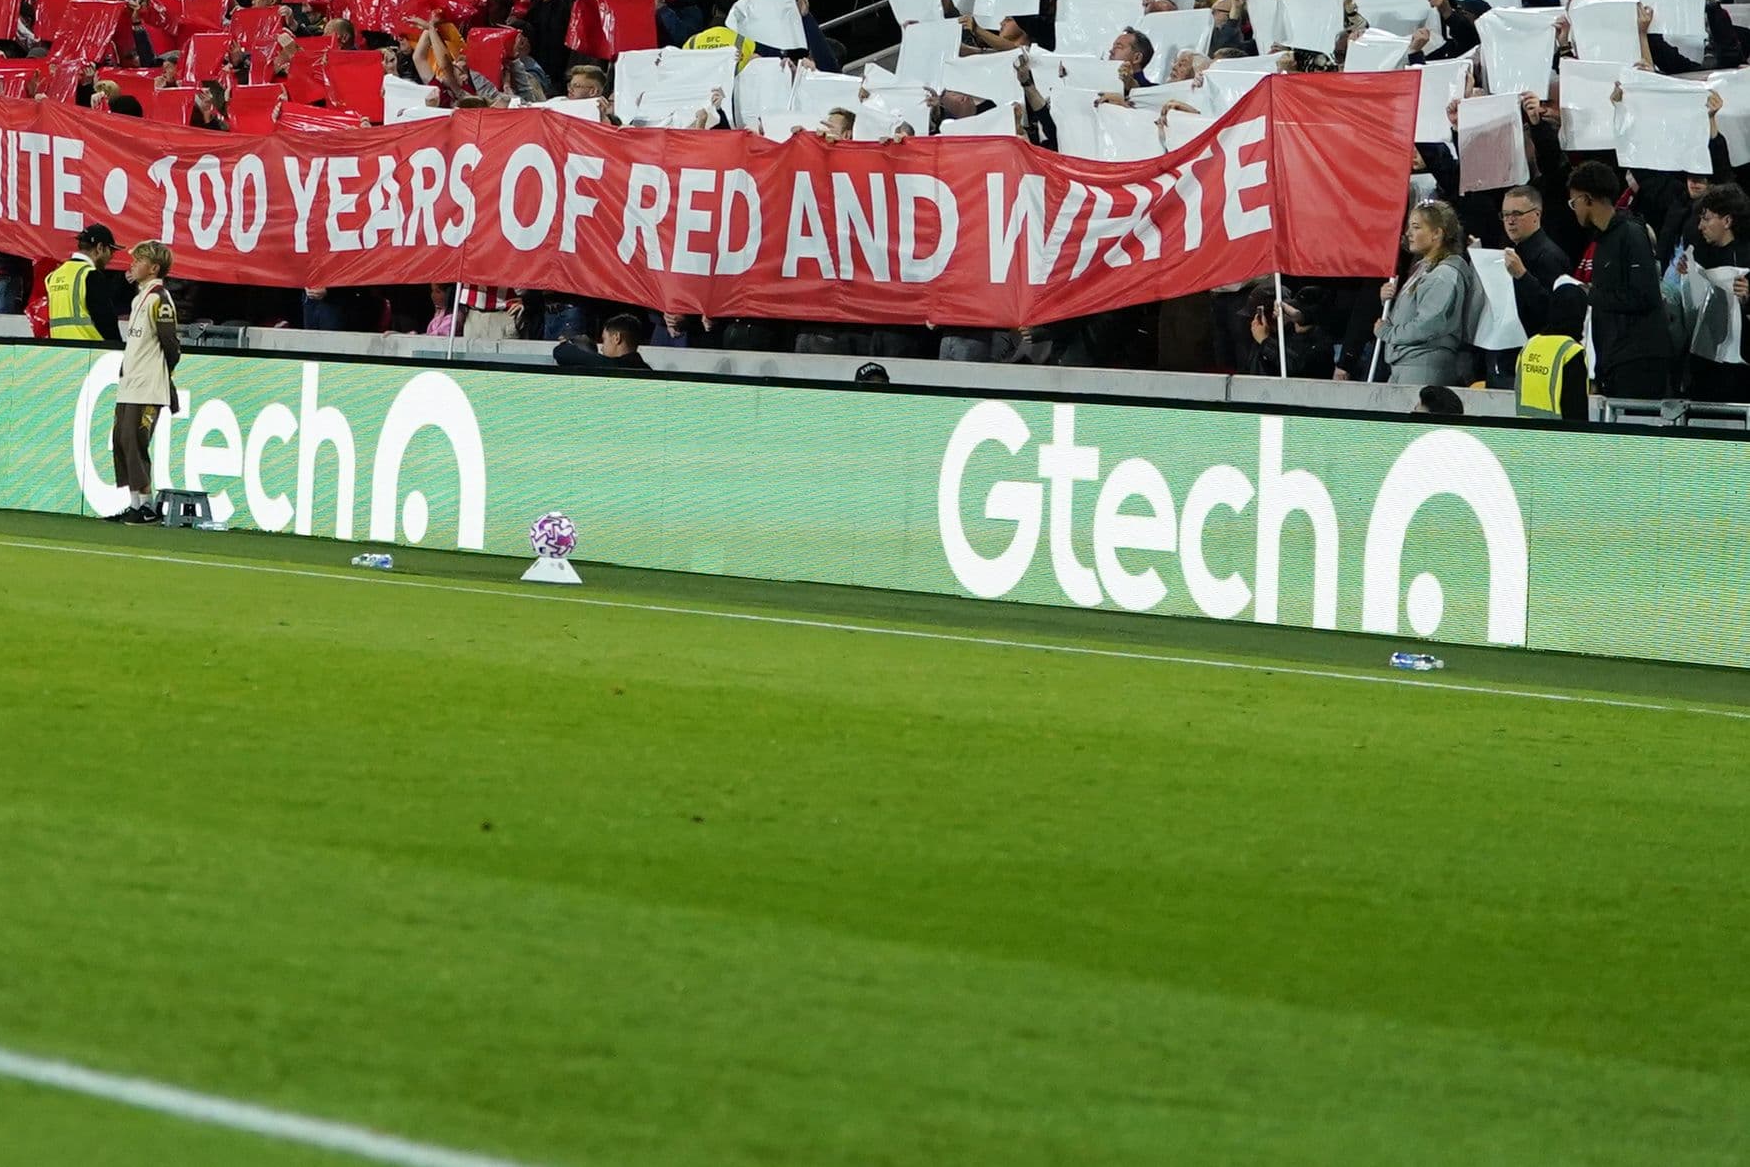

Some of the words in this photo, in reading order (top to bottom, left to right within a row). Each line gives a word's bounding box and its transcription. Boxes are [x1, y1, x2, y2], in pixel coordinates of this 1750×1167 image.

[147, 154, 267, 252] 100
[284, 143, 484, 252] YEARS
[499, 143, 605, 253] OF
[616, 163, 761, 275] RED
[782, 170, 959, 283] AND
[987, 115, 1273, 285] WHITE
[1523, 363, 1549, 376] TEWARD
[1528, 353, 1541, 362] BFC
[938, 400, 1338, 629] Gtech
